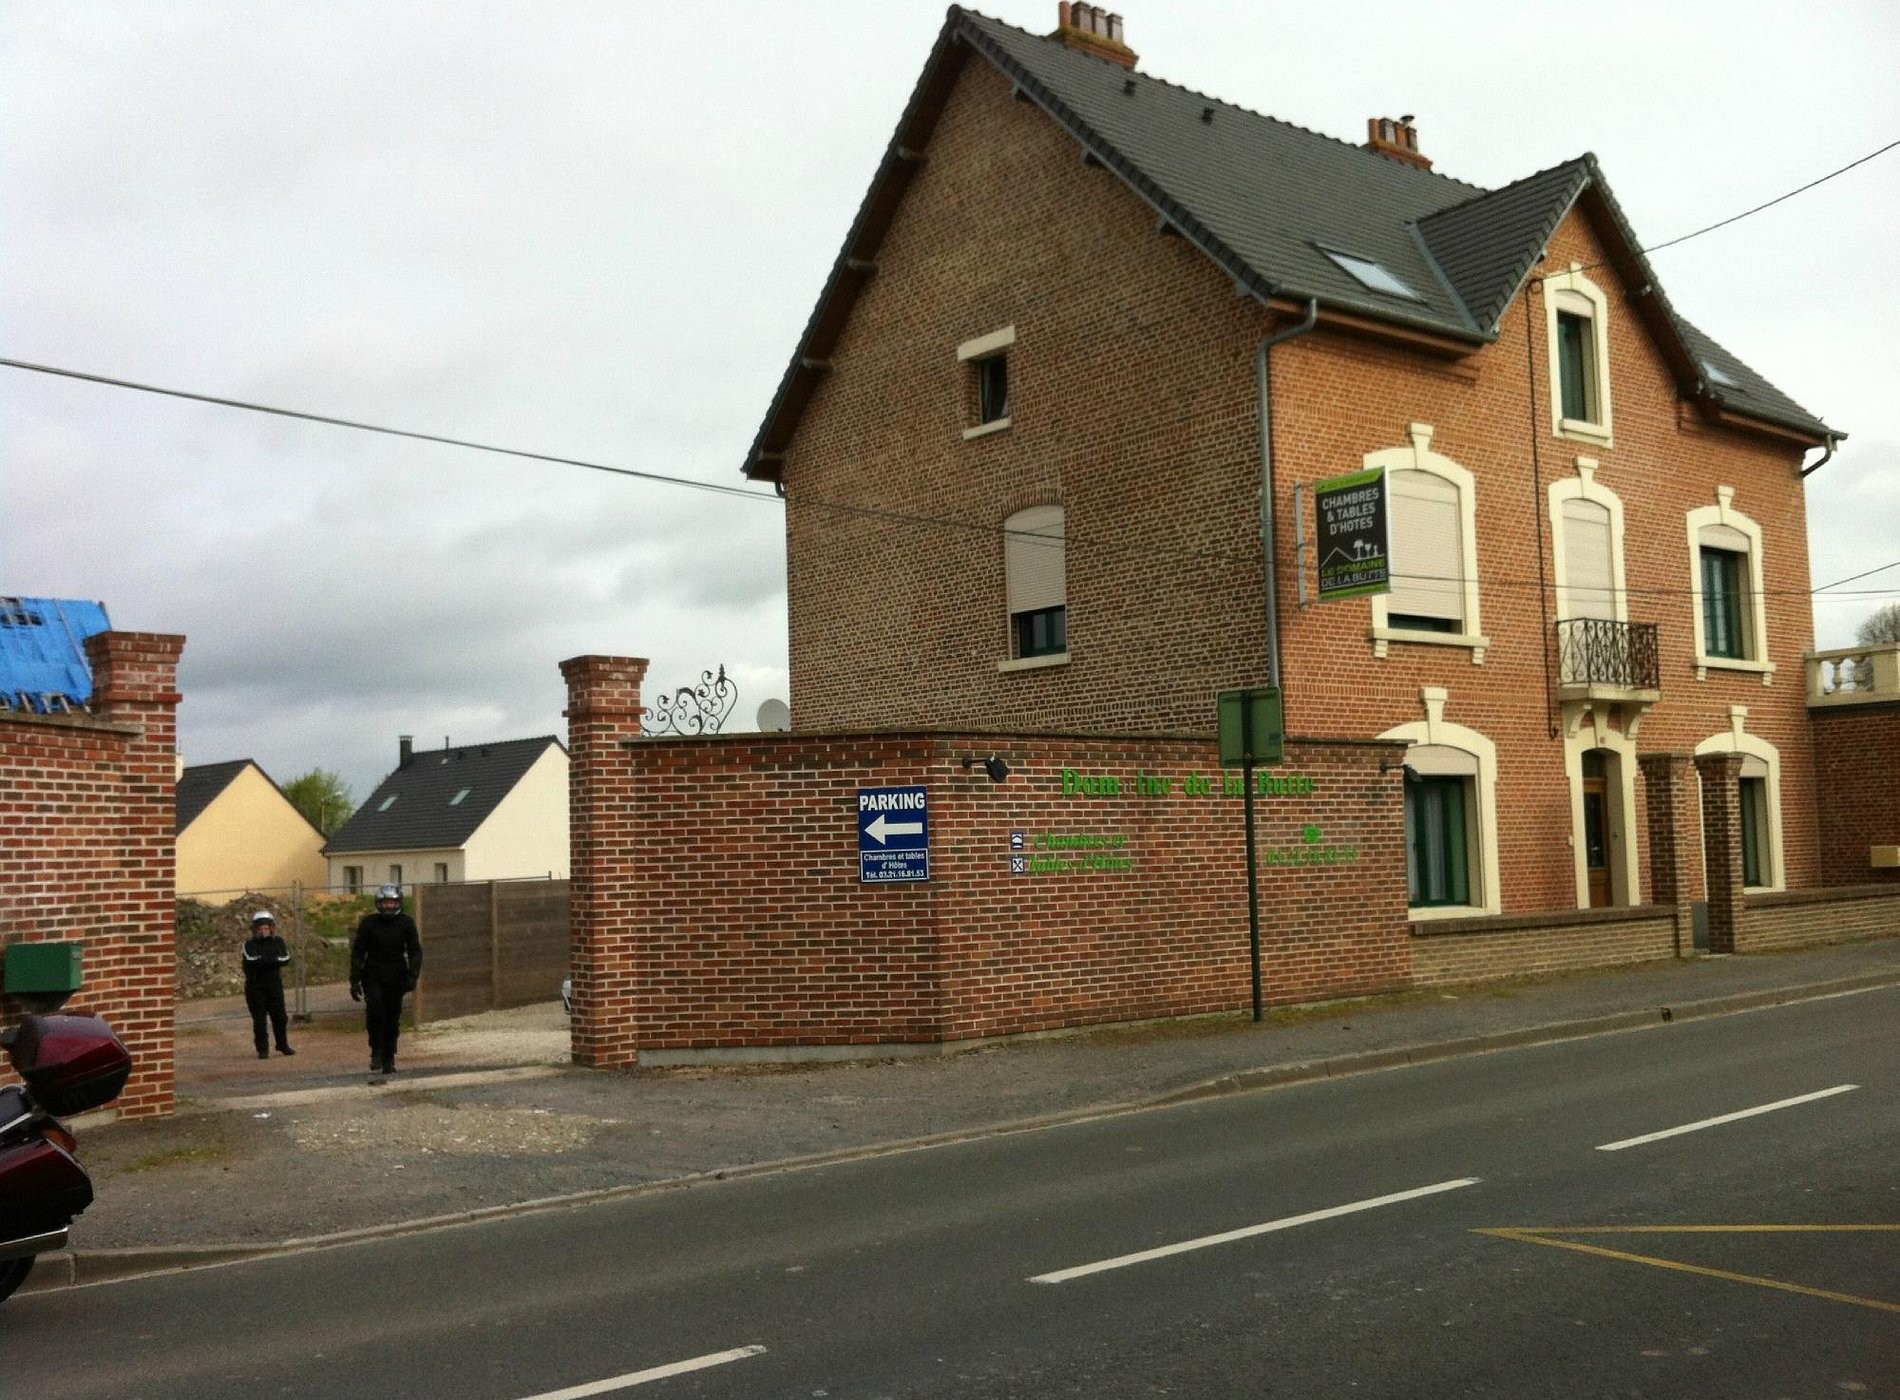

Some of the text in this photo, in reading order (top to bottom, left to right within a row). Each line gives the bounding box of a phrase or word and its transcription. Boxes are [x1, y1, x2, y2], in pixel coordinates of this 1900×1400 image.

[1322, 487, 1379, 510] CHAMBRES
[1327, 502, 1376, 523] & TABLES
[1185, 768, 1211, 796] de
[1224, 768, 1245, 796] la
[859, 792, 925, 811] PARKING
[863, 853, 897, 861] Chambres
[897, 852, 904, 860] et
